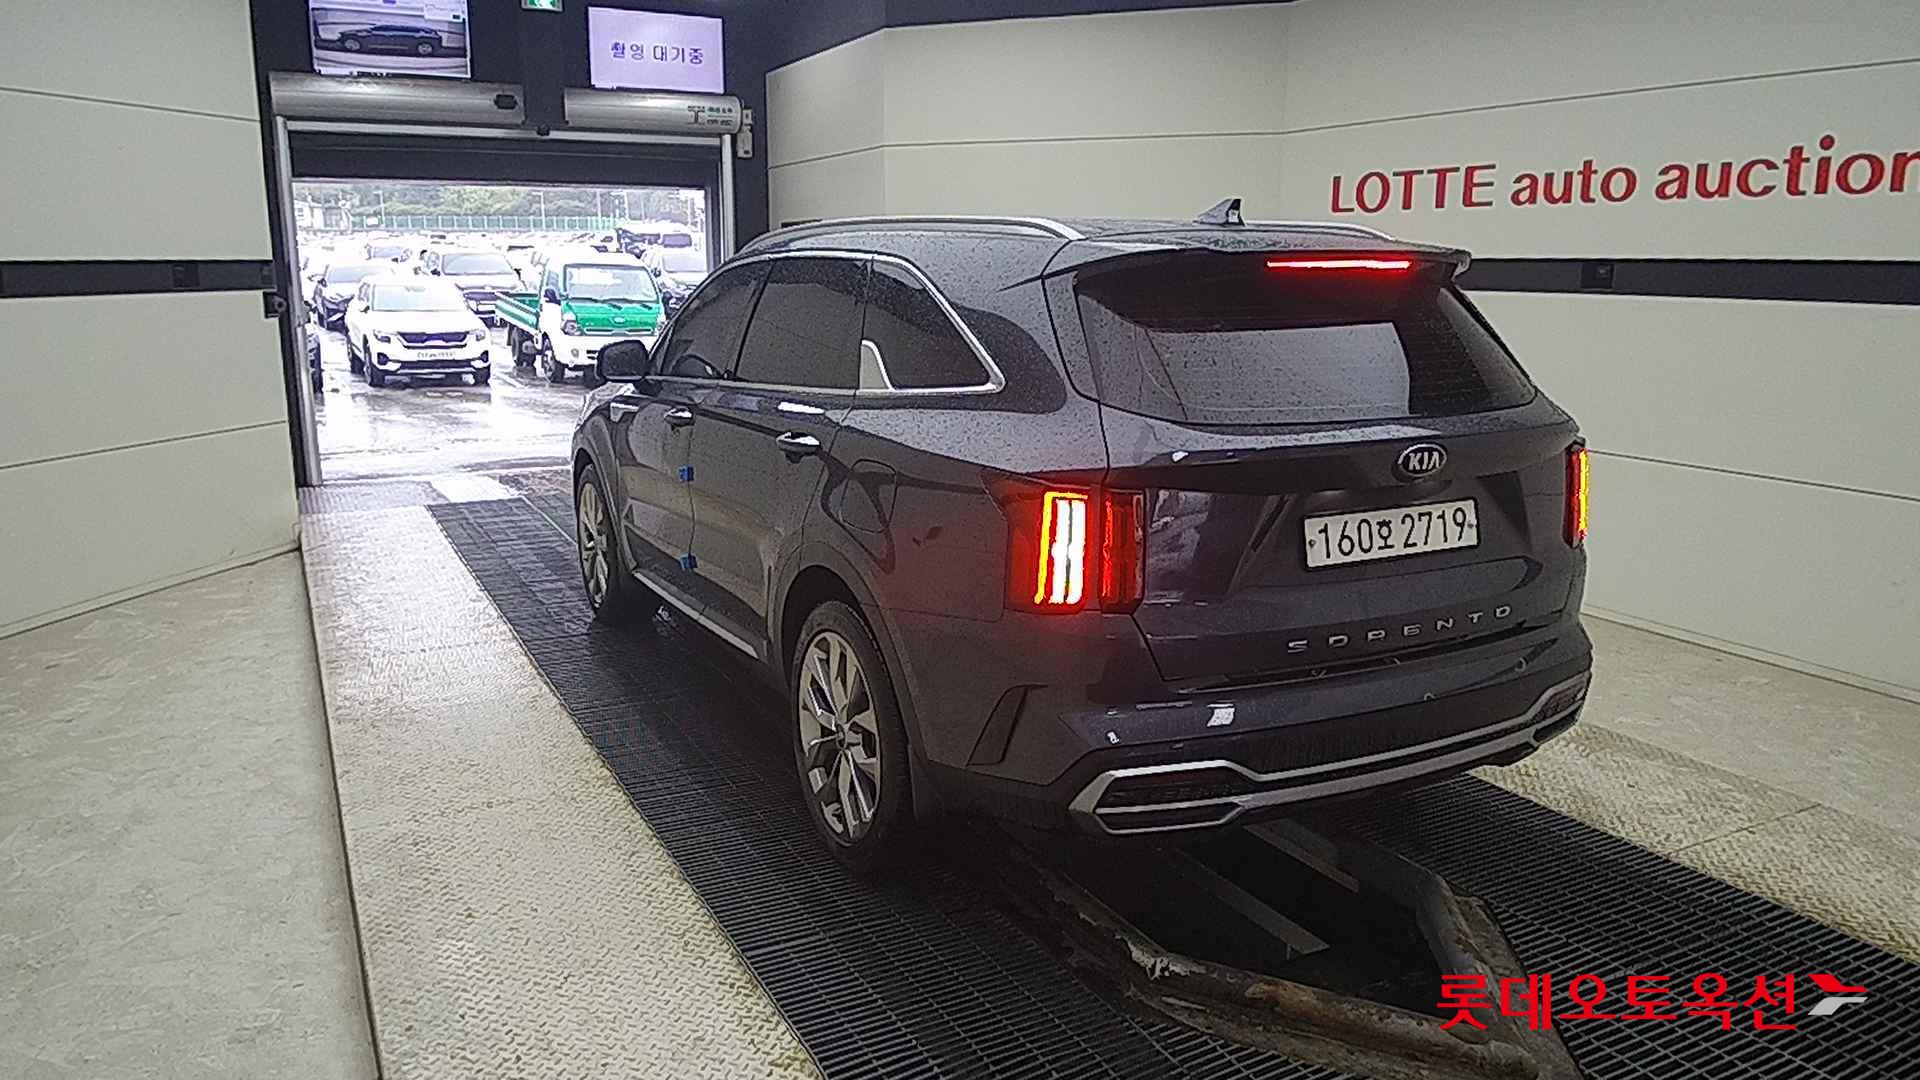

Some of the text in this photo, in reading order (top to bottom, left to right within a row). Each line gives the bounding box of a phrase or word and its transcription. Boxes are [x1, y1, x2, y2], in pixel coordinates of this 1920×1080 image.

[653, 45, 703, 64] 대기중
[1330, 164, 1496, 213] LOTTE
[1511, 160, 1637, 205] auto
[1408, 451, 1440, 470] KIA
[1318, 507, 1467, 559] 160호2719
[1287, 605, 1512, 653] SORENTO
